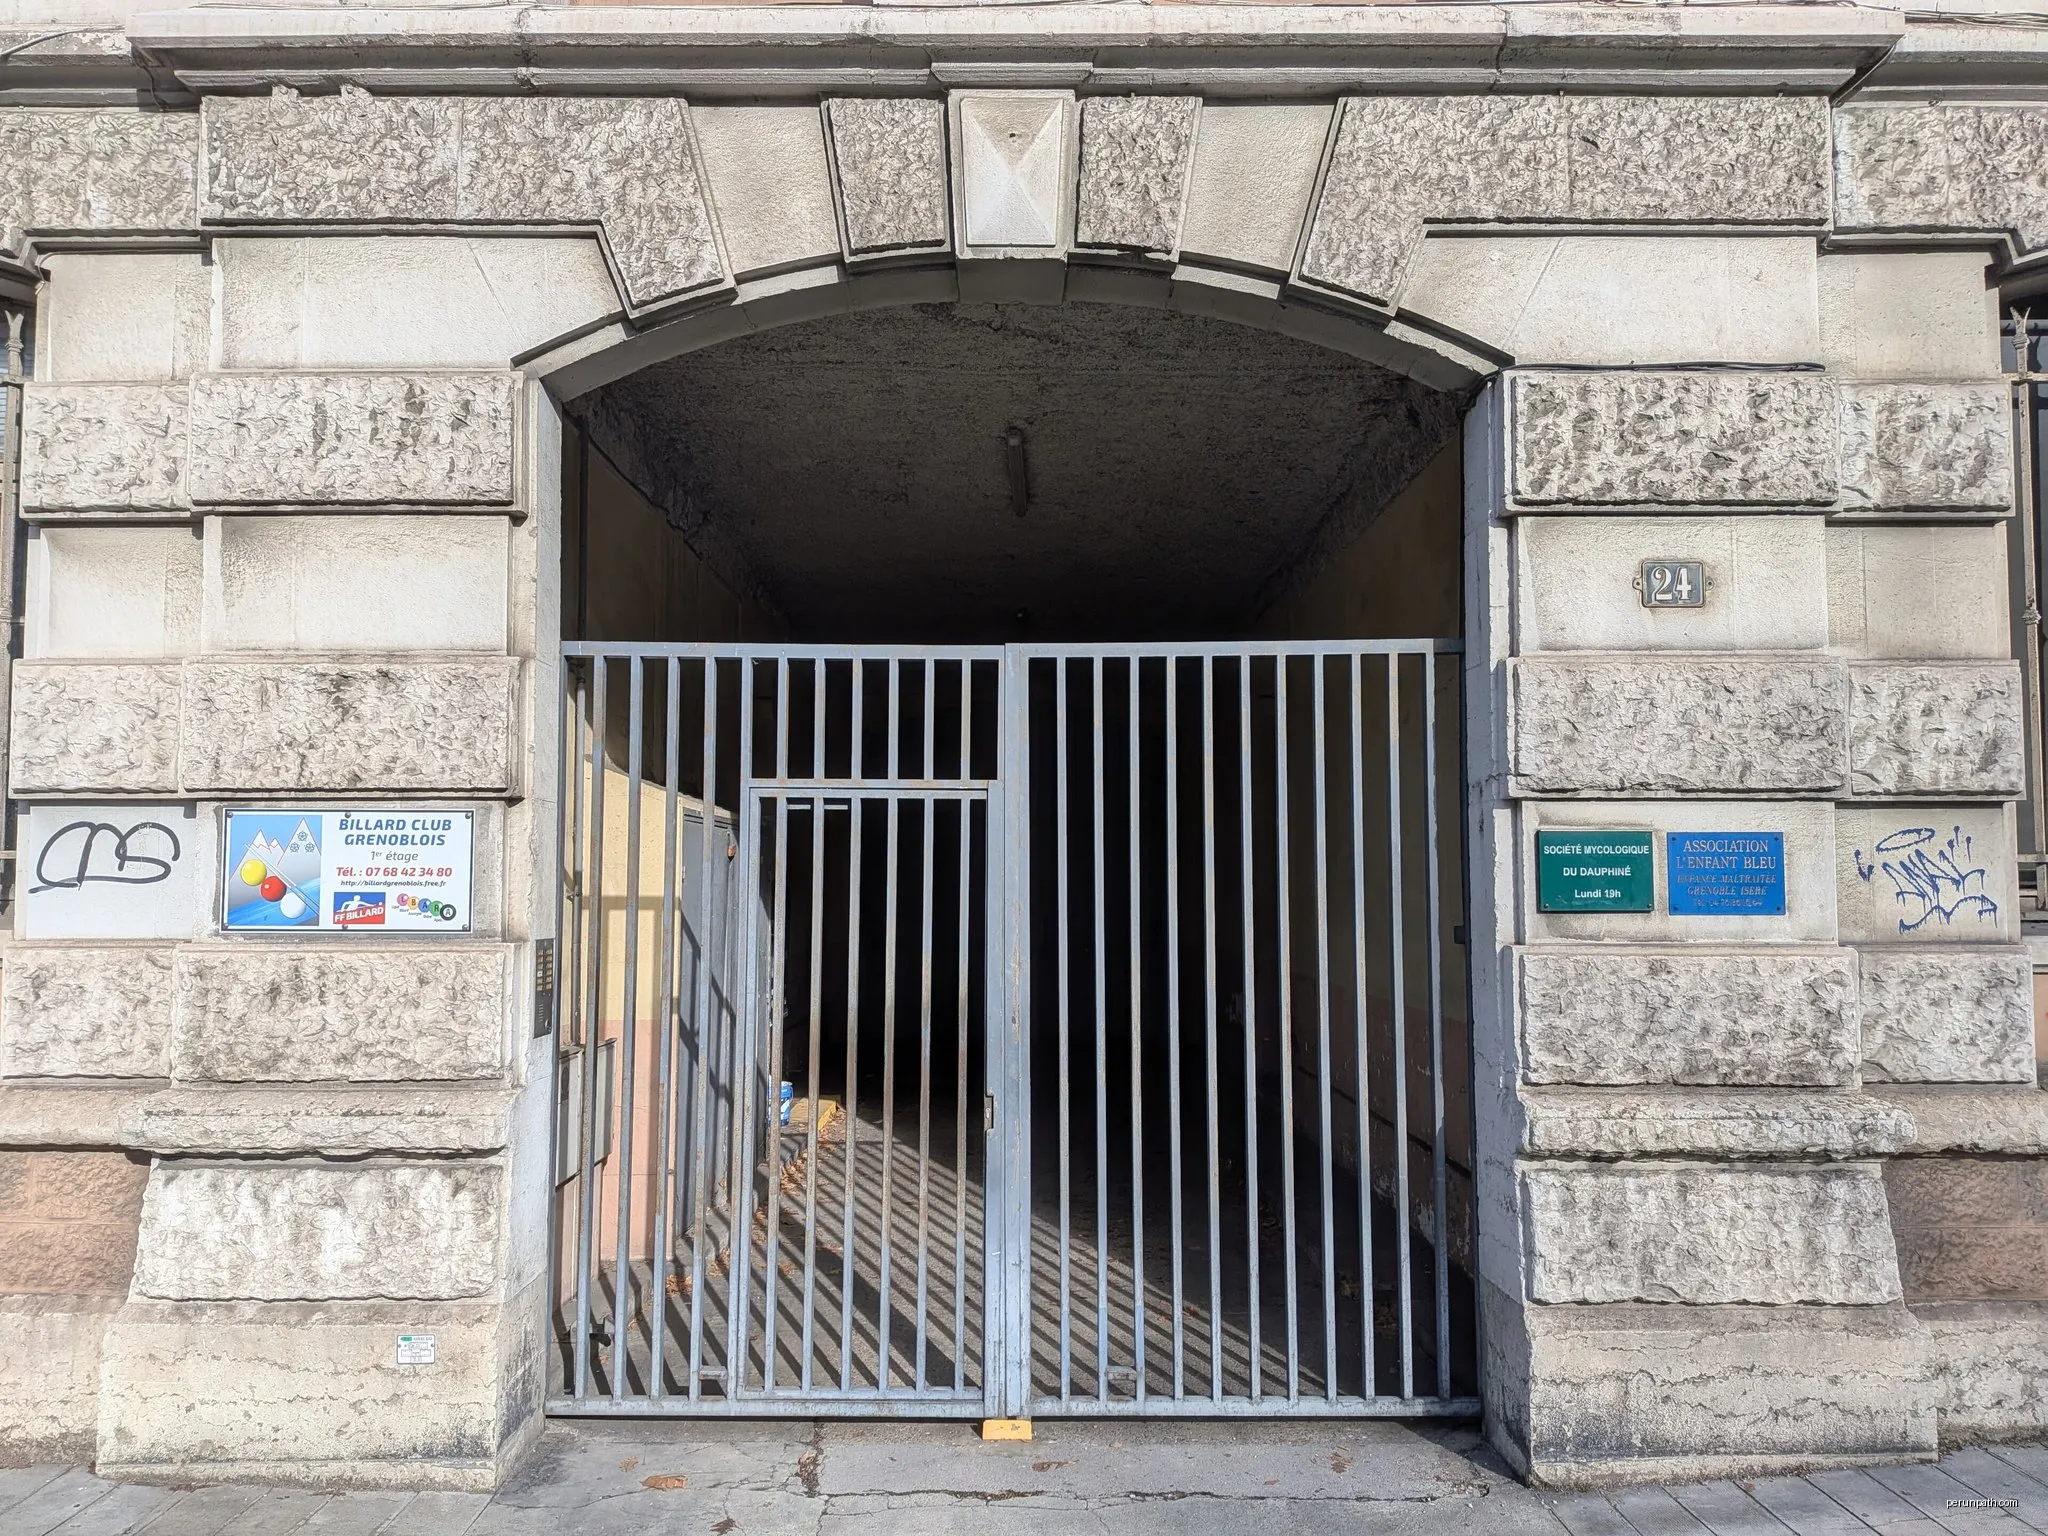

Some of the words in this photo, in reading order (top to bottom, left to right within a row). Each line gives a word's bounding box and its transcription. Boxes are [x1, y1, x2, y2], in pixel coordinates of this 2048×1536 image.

[1651, 566, 1692, 603] 24
[339, 819, 406, 831] BILLARD
[411, 819, 452, 831] CLUB
[344, 834, 446, 846] GRENOBLOIS
[1543, 843, 1582, 855] SOCIÉTÉ
[1583, 845, 1650, 855] MYCOLOGIQUE
[1683, 840, 1769, 853] ASSOCIATION
[385, 851, 419, 863] étage
[1676, 856, 1738, 869] L'ENFANT
[1743, 856, 1777, 869] BLEU
[336, 867, 357, 877] Tél.
[365, 867, 381, 877] 07
[382, 867, 398, 877] 68
[400, 867, 416, 877] 42
[418, 867, 434, 877] 34
[436, 867, 453, 877] 80
[1563, 867, 1577, 876] DU
[1580, 865, 1632, 876] DAUPHINÉ
[340, 880, 447, 888] http://billardgrenoblois.free.fr
[1574, 889, 1602, 898] Lundi
[1604, 889, 1621, 898] 19h
[334, 913, 346, 923] FF
[346, 906, 385, 920] BILLARD
